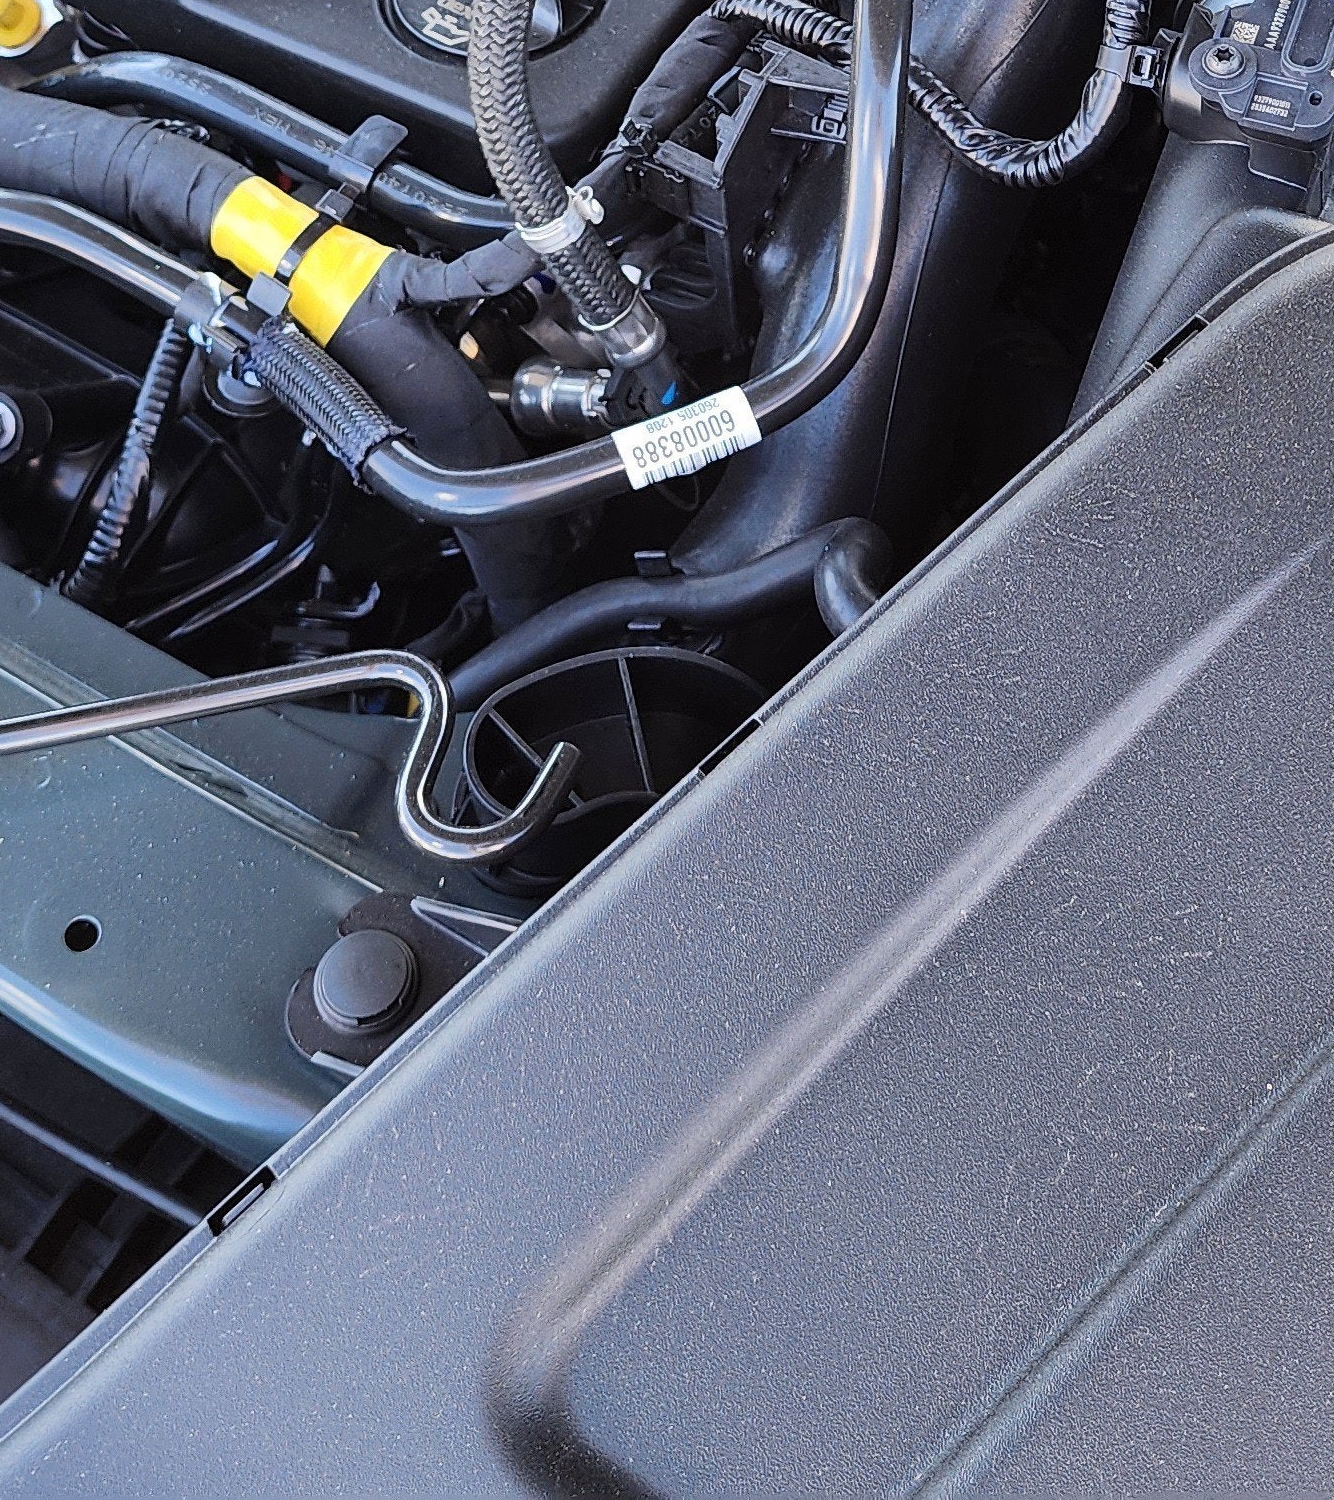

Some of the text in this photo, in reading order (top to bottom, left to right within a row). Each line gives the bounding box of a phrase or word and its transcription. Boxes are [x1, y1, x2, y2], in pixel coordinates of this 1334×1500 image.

[630, 408, 736, 470] 60008388
[645, 396, 720, 434] 260305 1208
